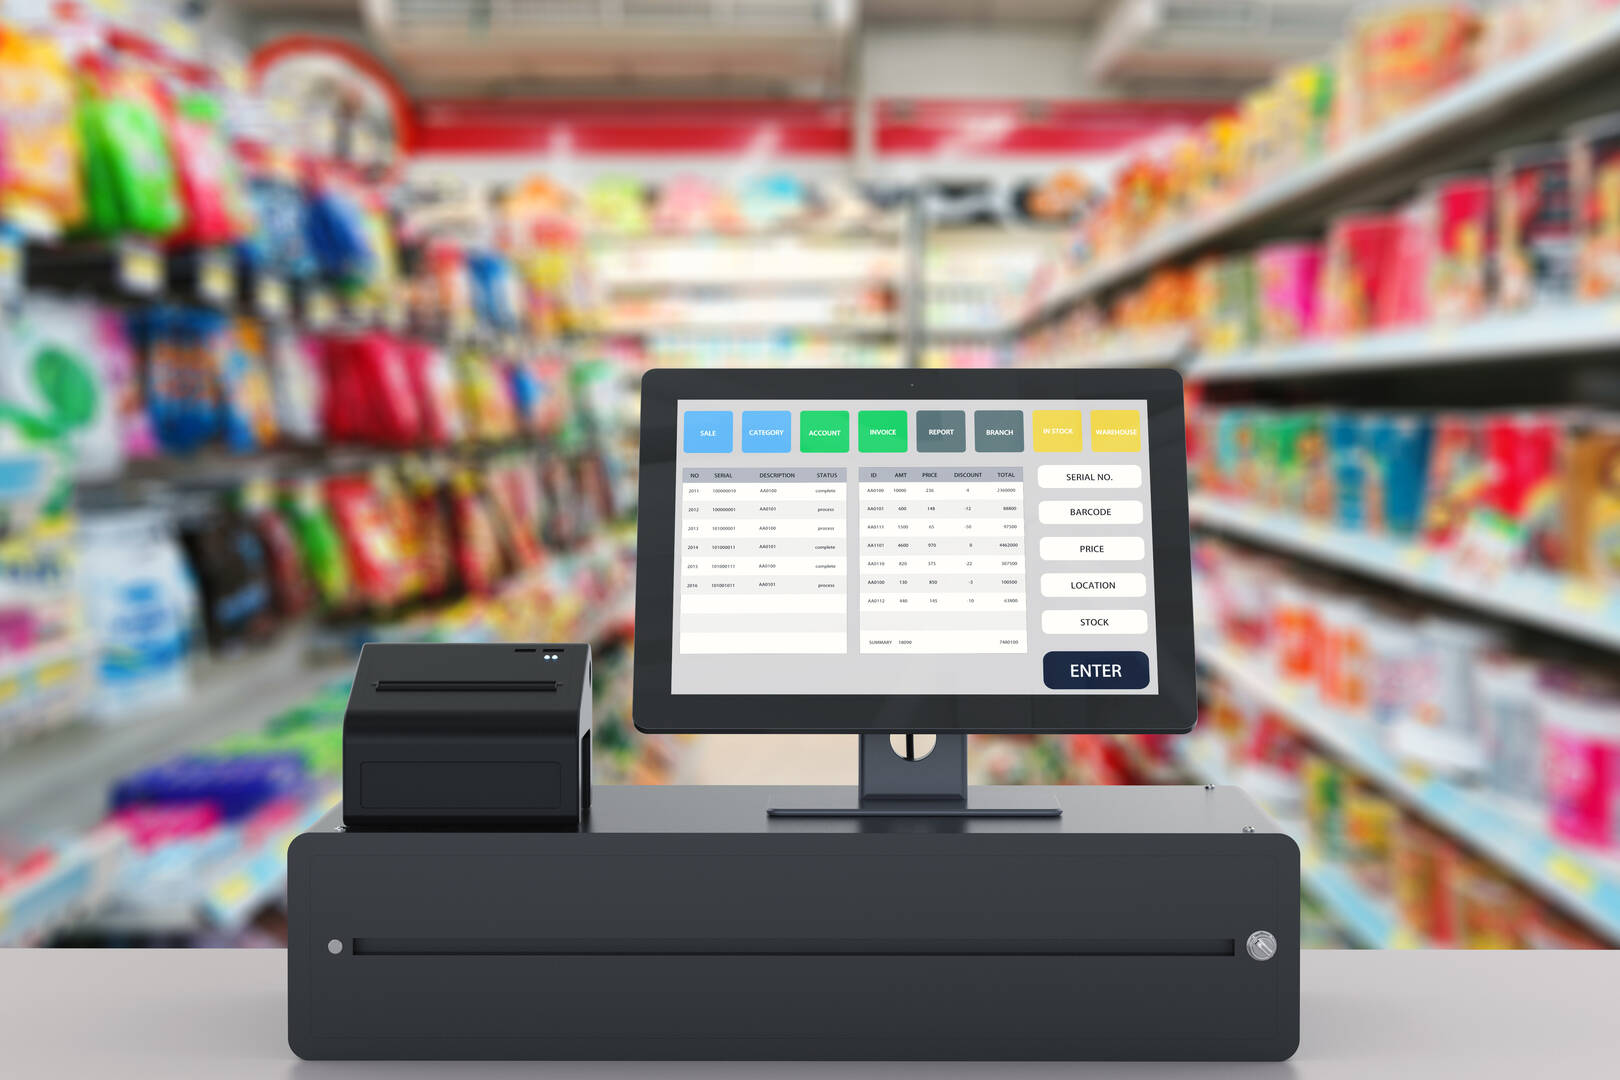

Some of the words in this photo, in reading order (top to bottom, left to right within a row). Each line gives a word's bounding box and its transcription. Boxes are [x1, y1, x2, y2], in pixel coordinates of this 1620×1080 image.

[699, 429, 717, 437] SALE
[748, 428, 785, 437] CATEGORY
[808, 429, 842, 437] ACCOUNT
[869, 428, 897, 436] INVOICE
[927, 428, 955, 436] REPORT
[985, 428, 1015, 437] BRANCH
[1042, 427, 1051, 435] IN
[1052, 427, 1074, 435] STOCK
[1095, 428, 1138, 436] WAREHOUSE
[1066, 473, 1095, 482] SERIAL
[1097, 473, 1113, 482] NO.
[1069, 508, 1112, 516] BARCODE
[814, 544, 836, 552] complete
[1079, 544, 1105, 553] PRICE
[1070, 581, 1116, 590] LOCATION
[1080, 618, 1110, 627] STOCK
[1070, 663, 1122, 678] ENTER
